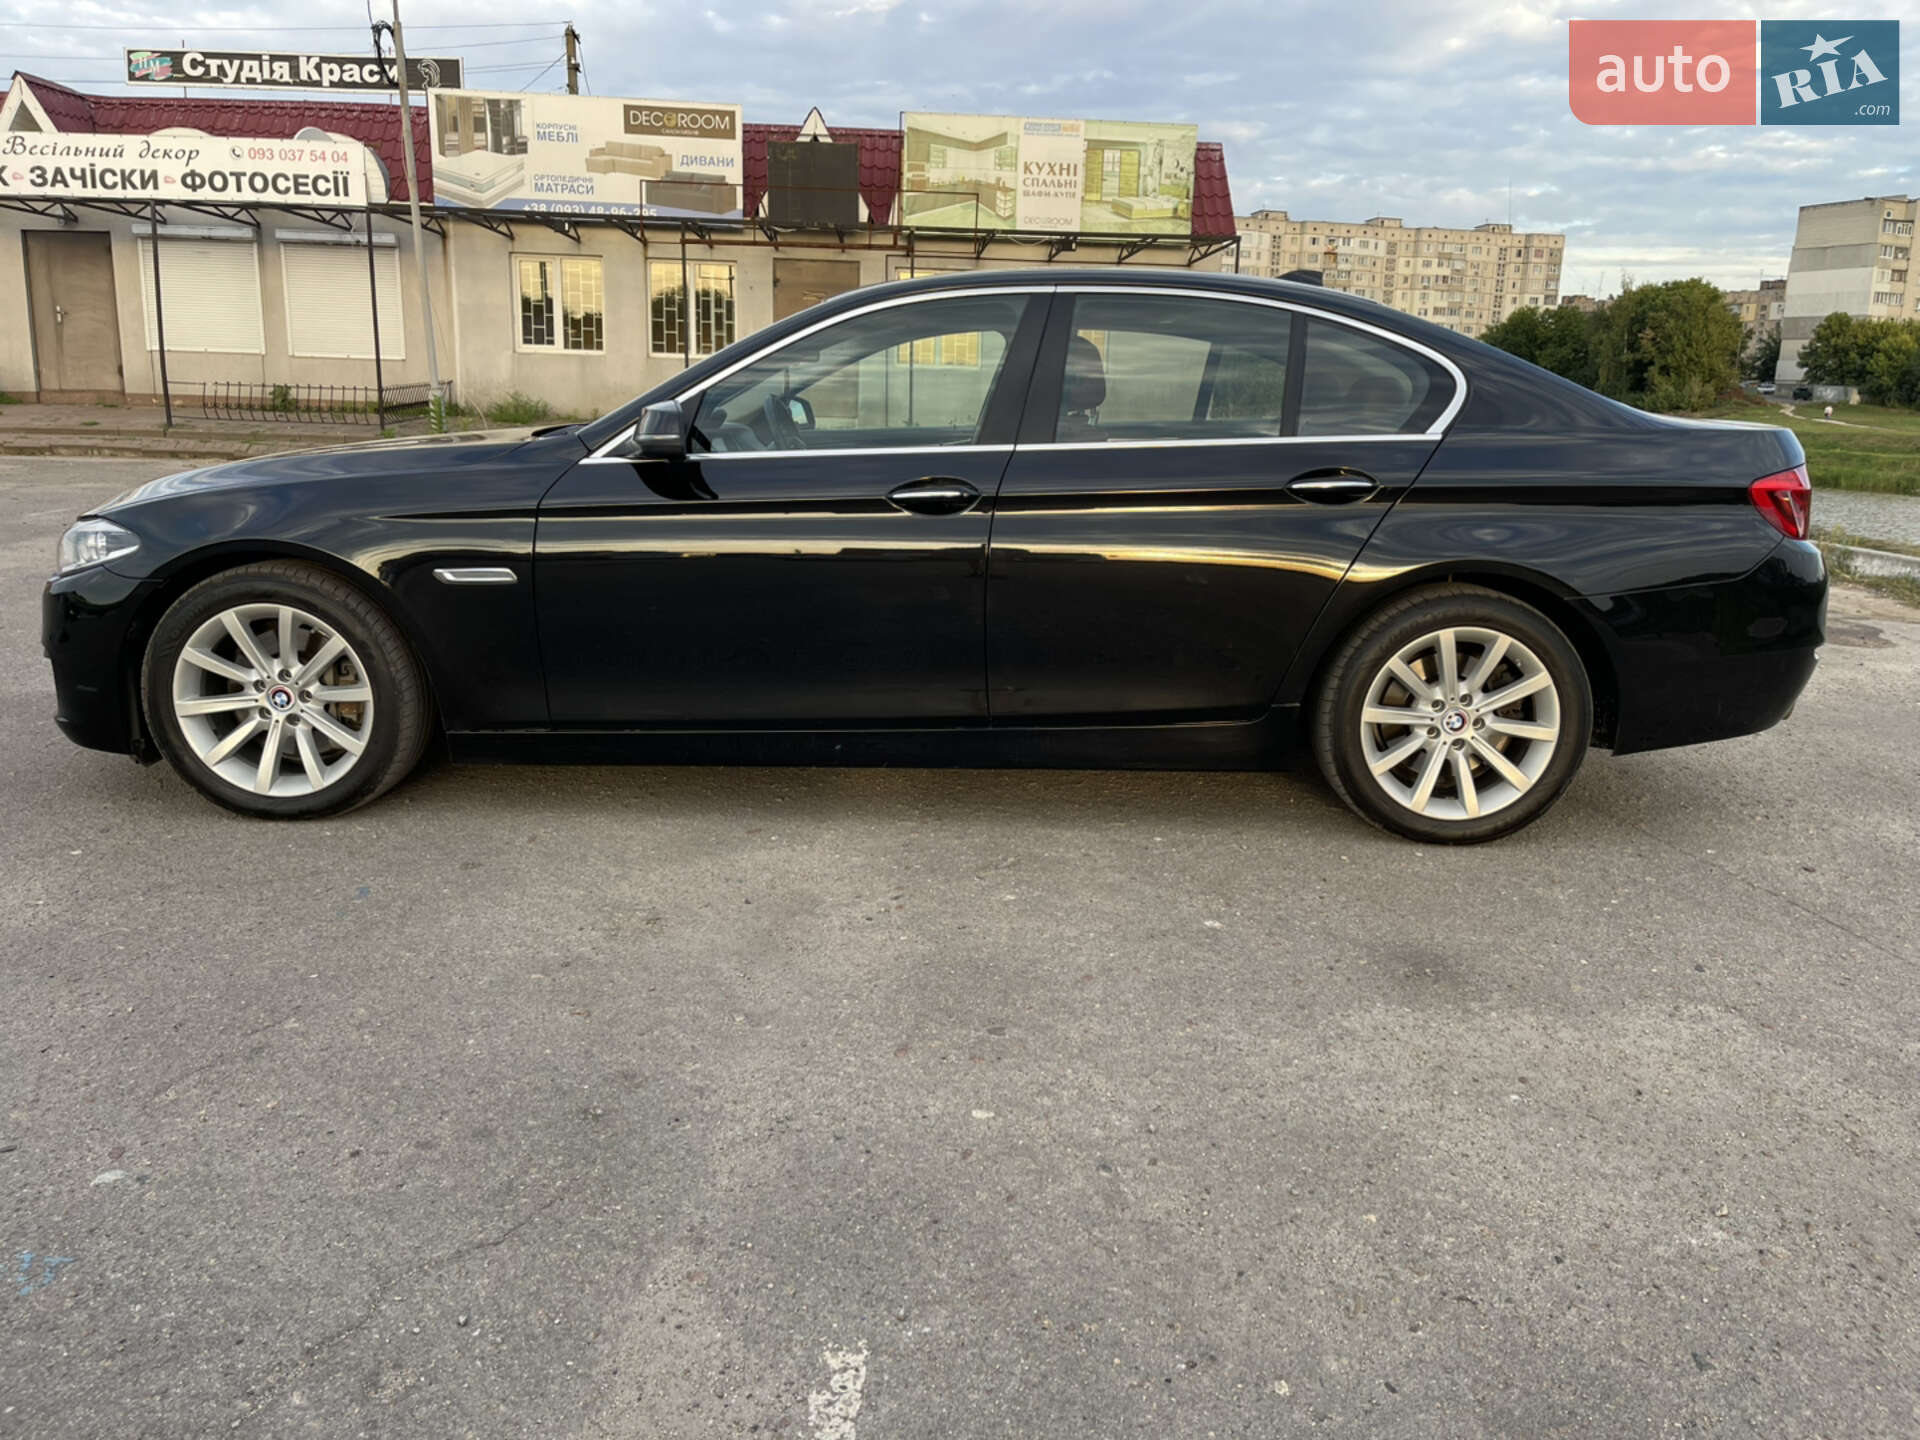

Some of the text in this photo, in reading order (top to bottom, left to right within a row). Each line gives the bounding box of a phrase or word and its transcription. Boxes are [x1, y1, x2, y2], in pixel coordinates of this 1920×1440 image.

[182, 52, 290, 83] Студія
[536, 131, 578, 143] МЕБЛІ
[3, 135, 200, 166] Весільний декор
[248, 147, 349, 163] 093 037 54 04
[680, 154, 735, 167] ДИВАНИ
[1023, 161, 1078, 177] КУХНІ
[534, 183, 595, 195] МАТРАСИ
[1023, 177, 1077, 189] СПАЛЬНІ
